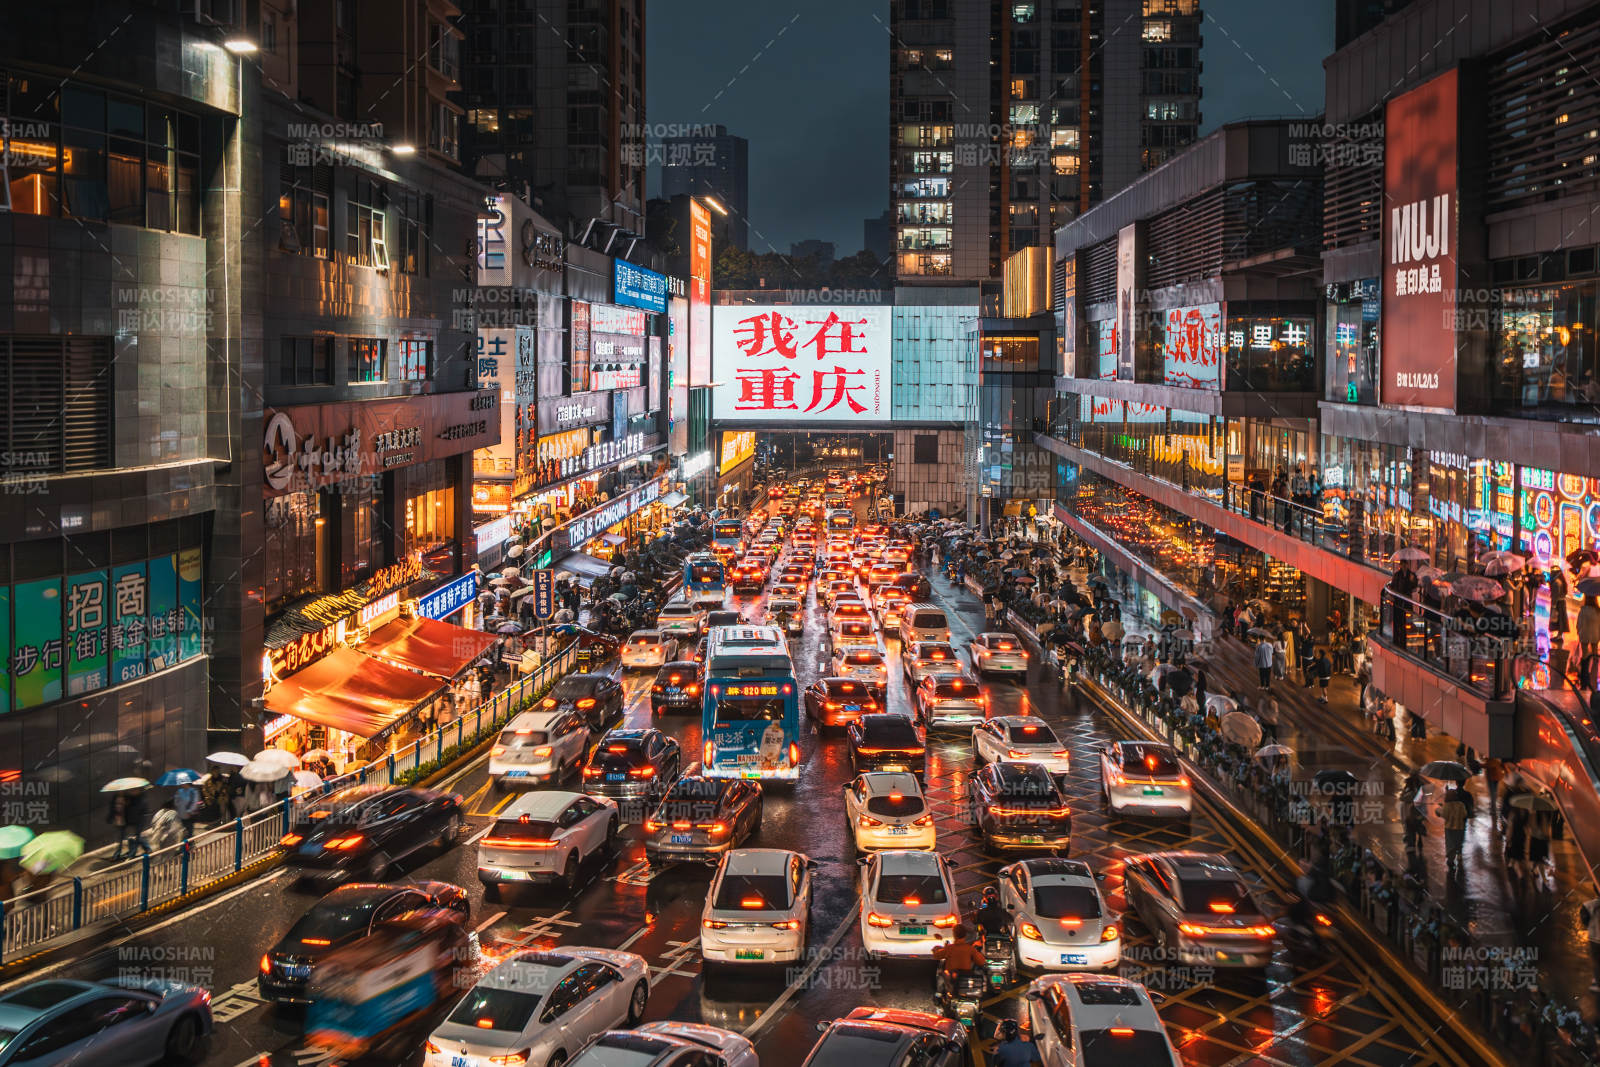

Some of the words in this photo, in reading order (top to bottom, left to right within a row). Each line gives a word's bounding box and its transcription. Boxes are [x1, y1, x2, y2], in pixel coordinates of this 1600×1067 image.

[1391, 193, 1449, 264] MUJI
[1396, 264, 1442, 296] 無印良品
[733, 311, 868, 360] 我在
[734, 366, 869, 415] 重庆
[569, 519, 586, 547] THIS
[586, 516, 594, 537] IS
[595, 498, 628, 534] CHONGQING
[68, 573, 147, 632] 招商
[121, 662, 145, 682] 630
[743, 686, 760, 696] 820
